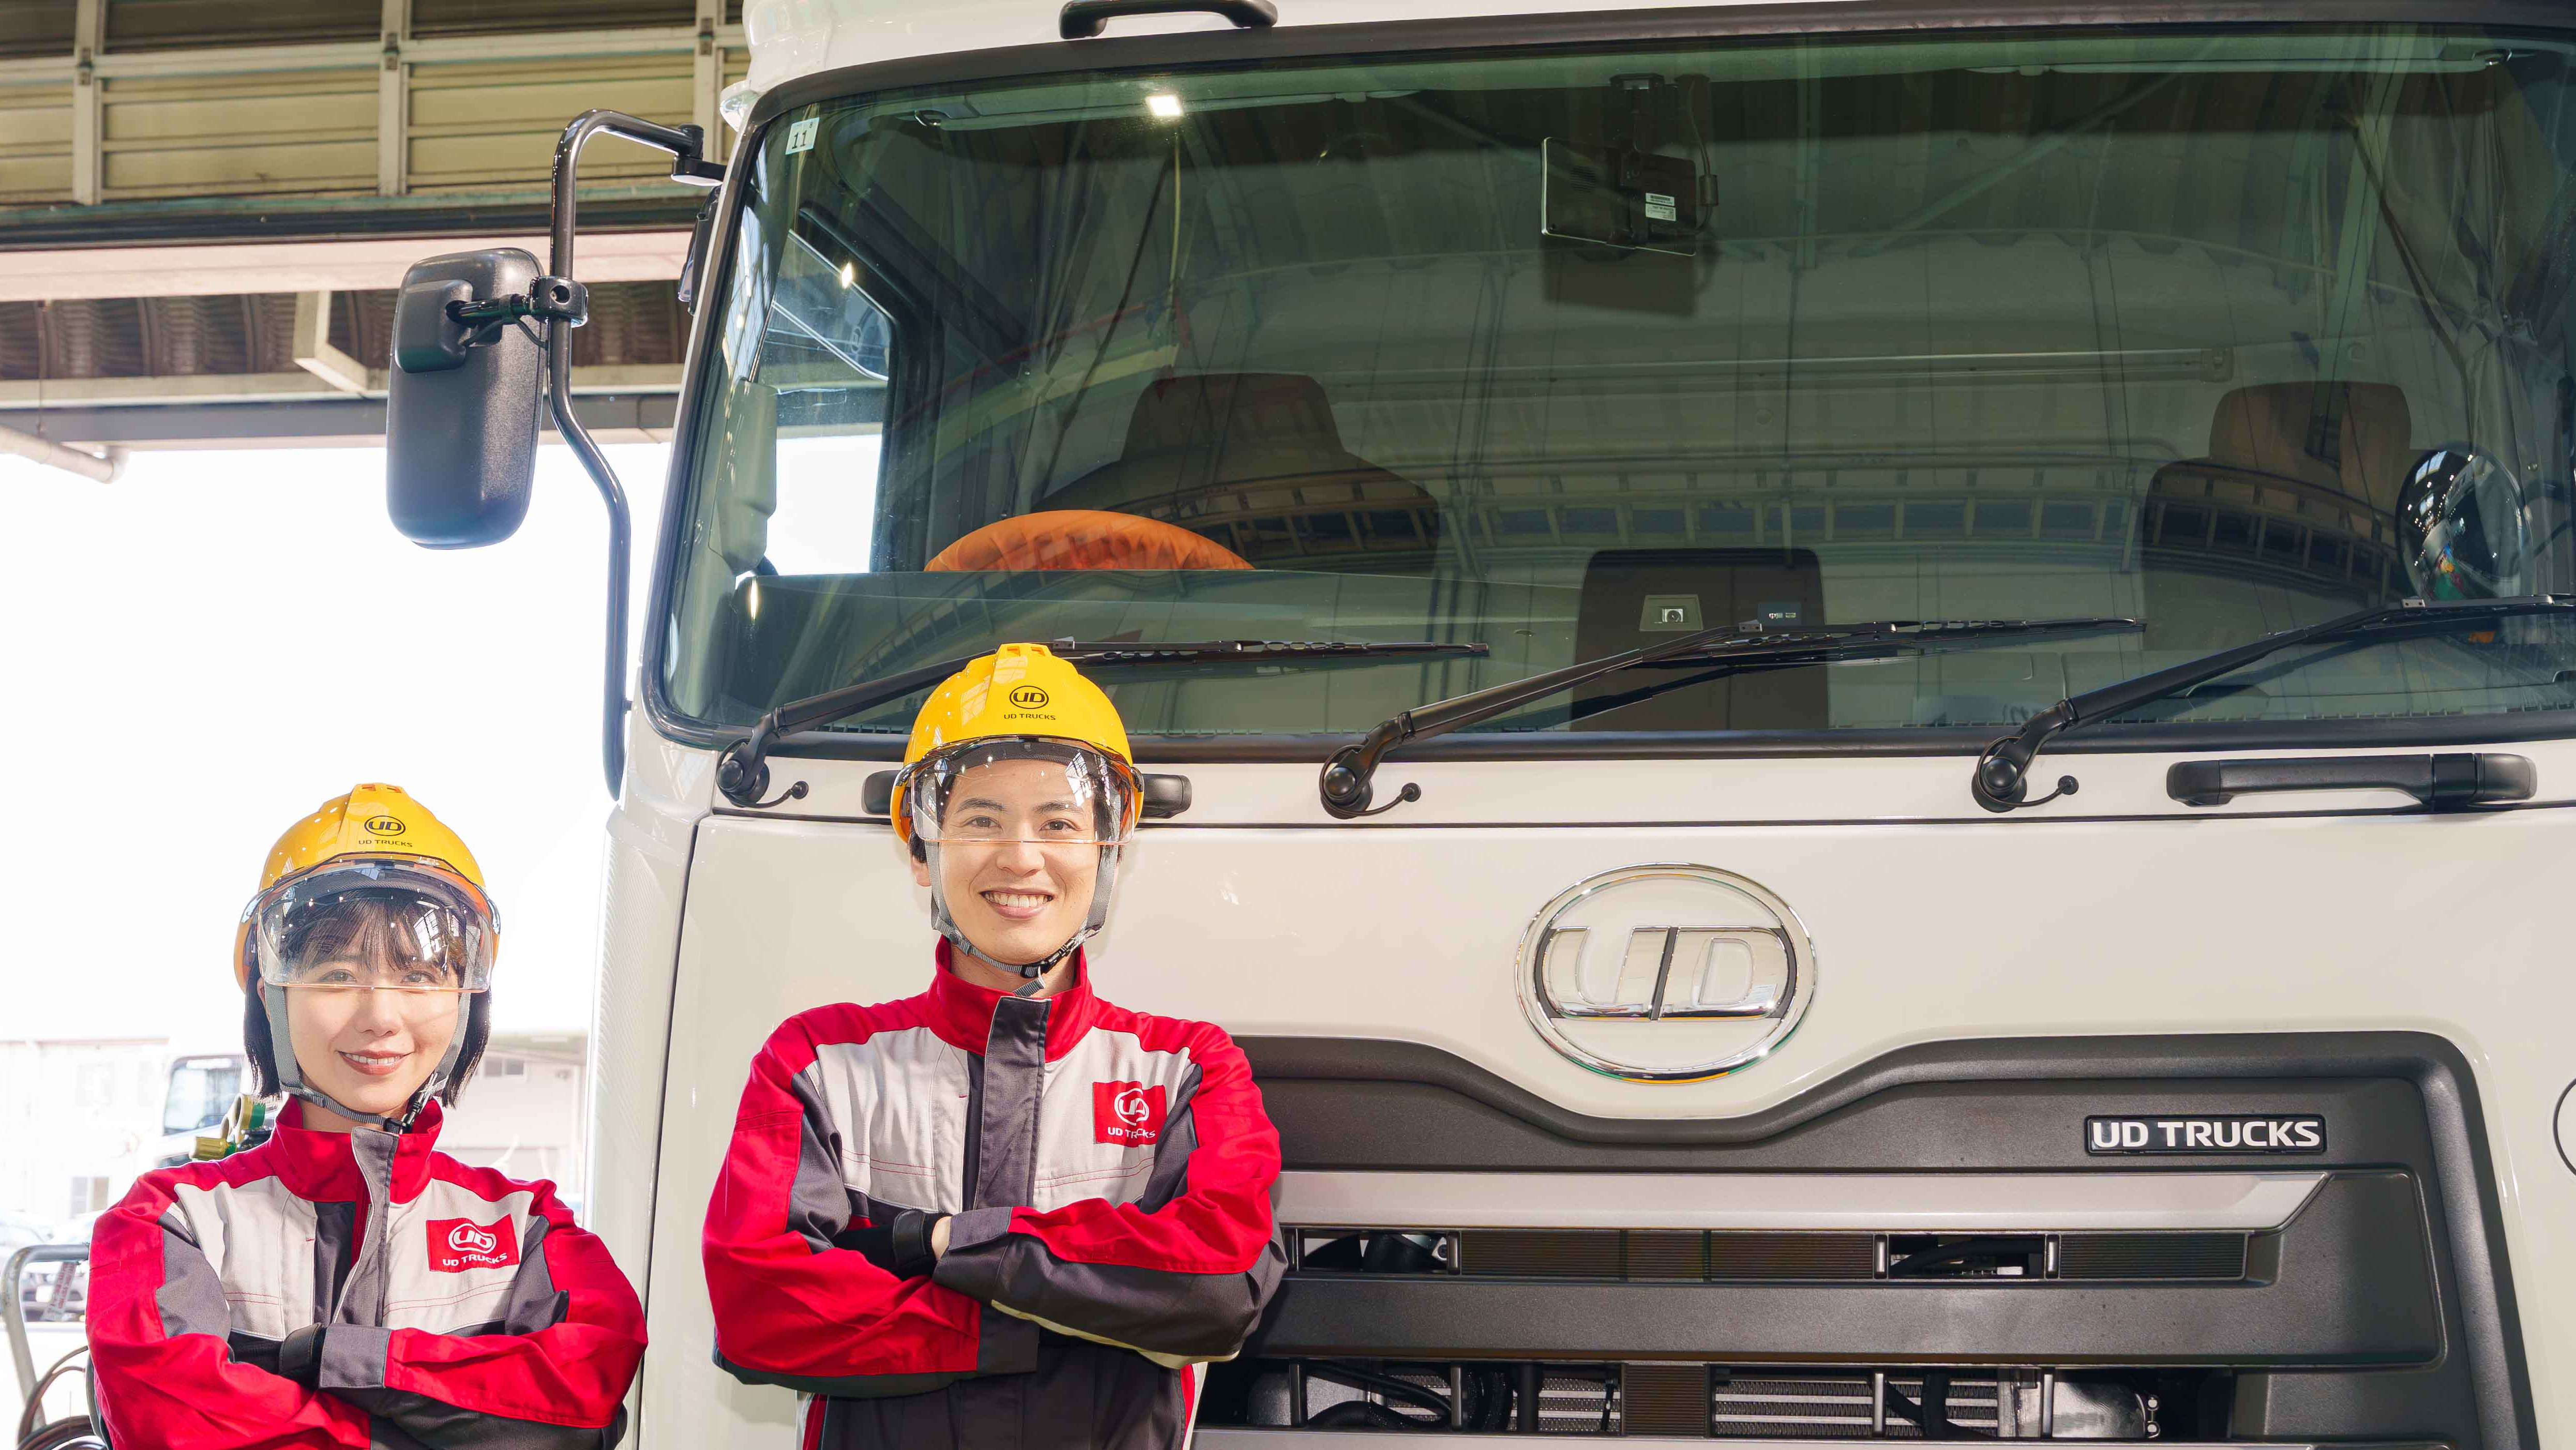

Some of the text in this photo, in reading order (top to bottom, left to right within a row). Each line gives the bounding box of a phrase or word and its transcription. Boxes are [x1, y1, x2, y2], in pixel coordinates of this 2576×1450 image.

[792, 130, 807, 149] 11
[1013, 692, 1045, 703] UD
[368, 821, 401, 831] UD
[374, 839, 413, 848] TRUCKS
[1541, 926, 1791, 1021] UD
[1107, 1126, 1156, 1139] UD TRCKS
[2092, 1121, 2320, 1147] UD TRUCKS
[453, 1230, 492, 1249] UD
[461, 1252, 508, 1264] TRUCKS
